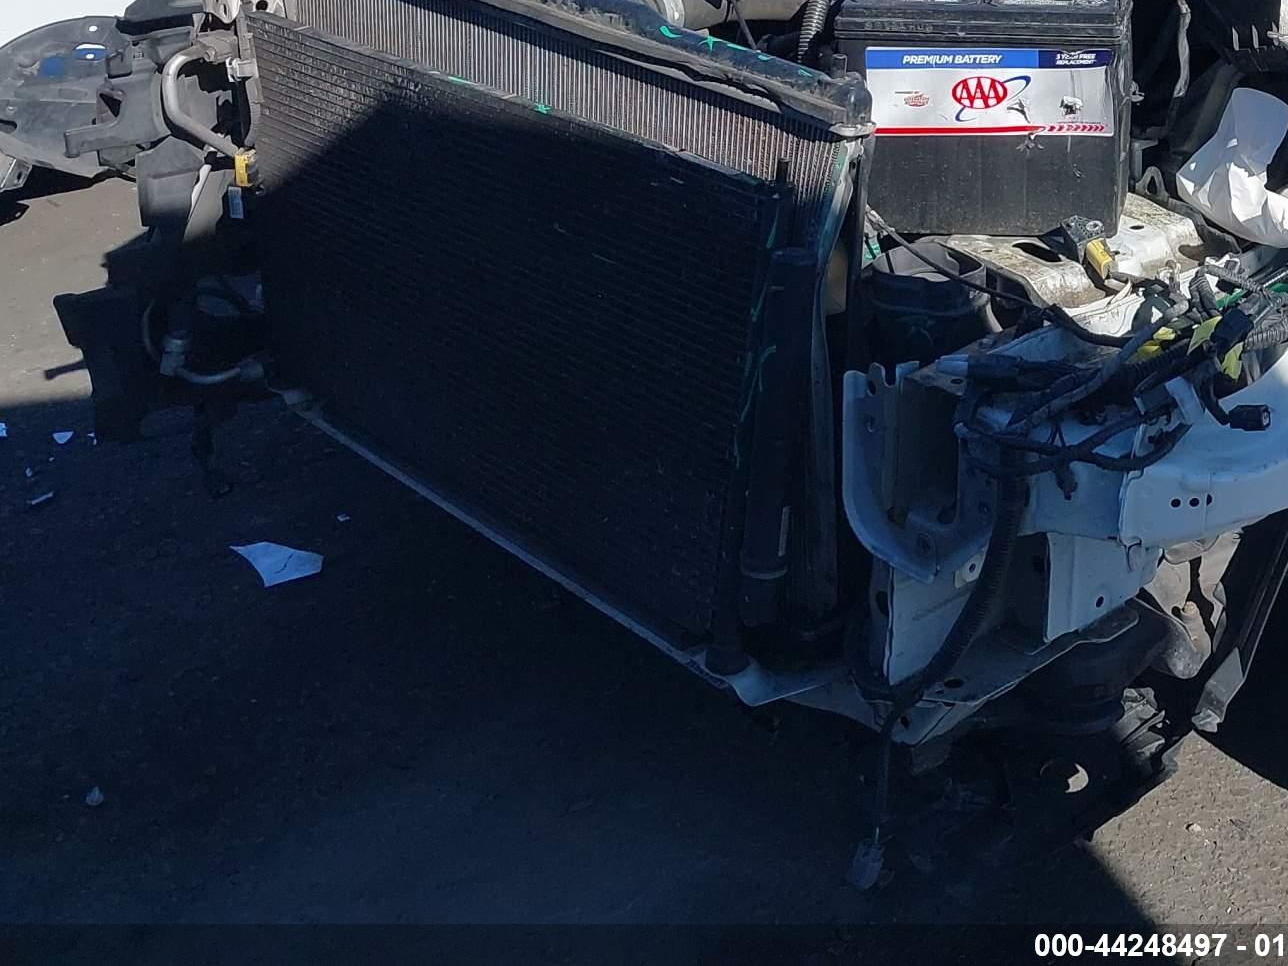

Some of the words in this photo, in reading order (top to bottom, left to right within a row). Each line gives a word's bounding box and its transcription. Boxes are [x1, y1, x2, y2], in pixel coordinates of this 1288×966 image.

[902, 54, 953, 66] PREMIUM
[954, 54, 1003, 65] BATTERY
[959, 78, 1003, 107] AAA
